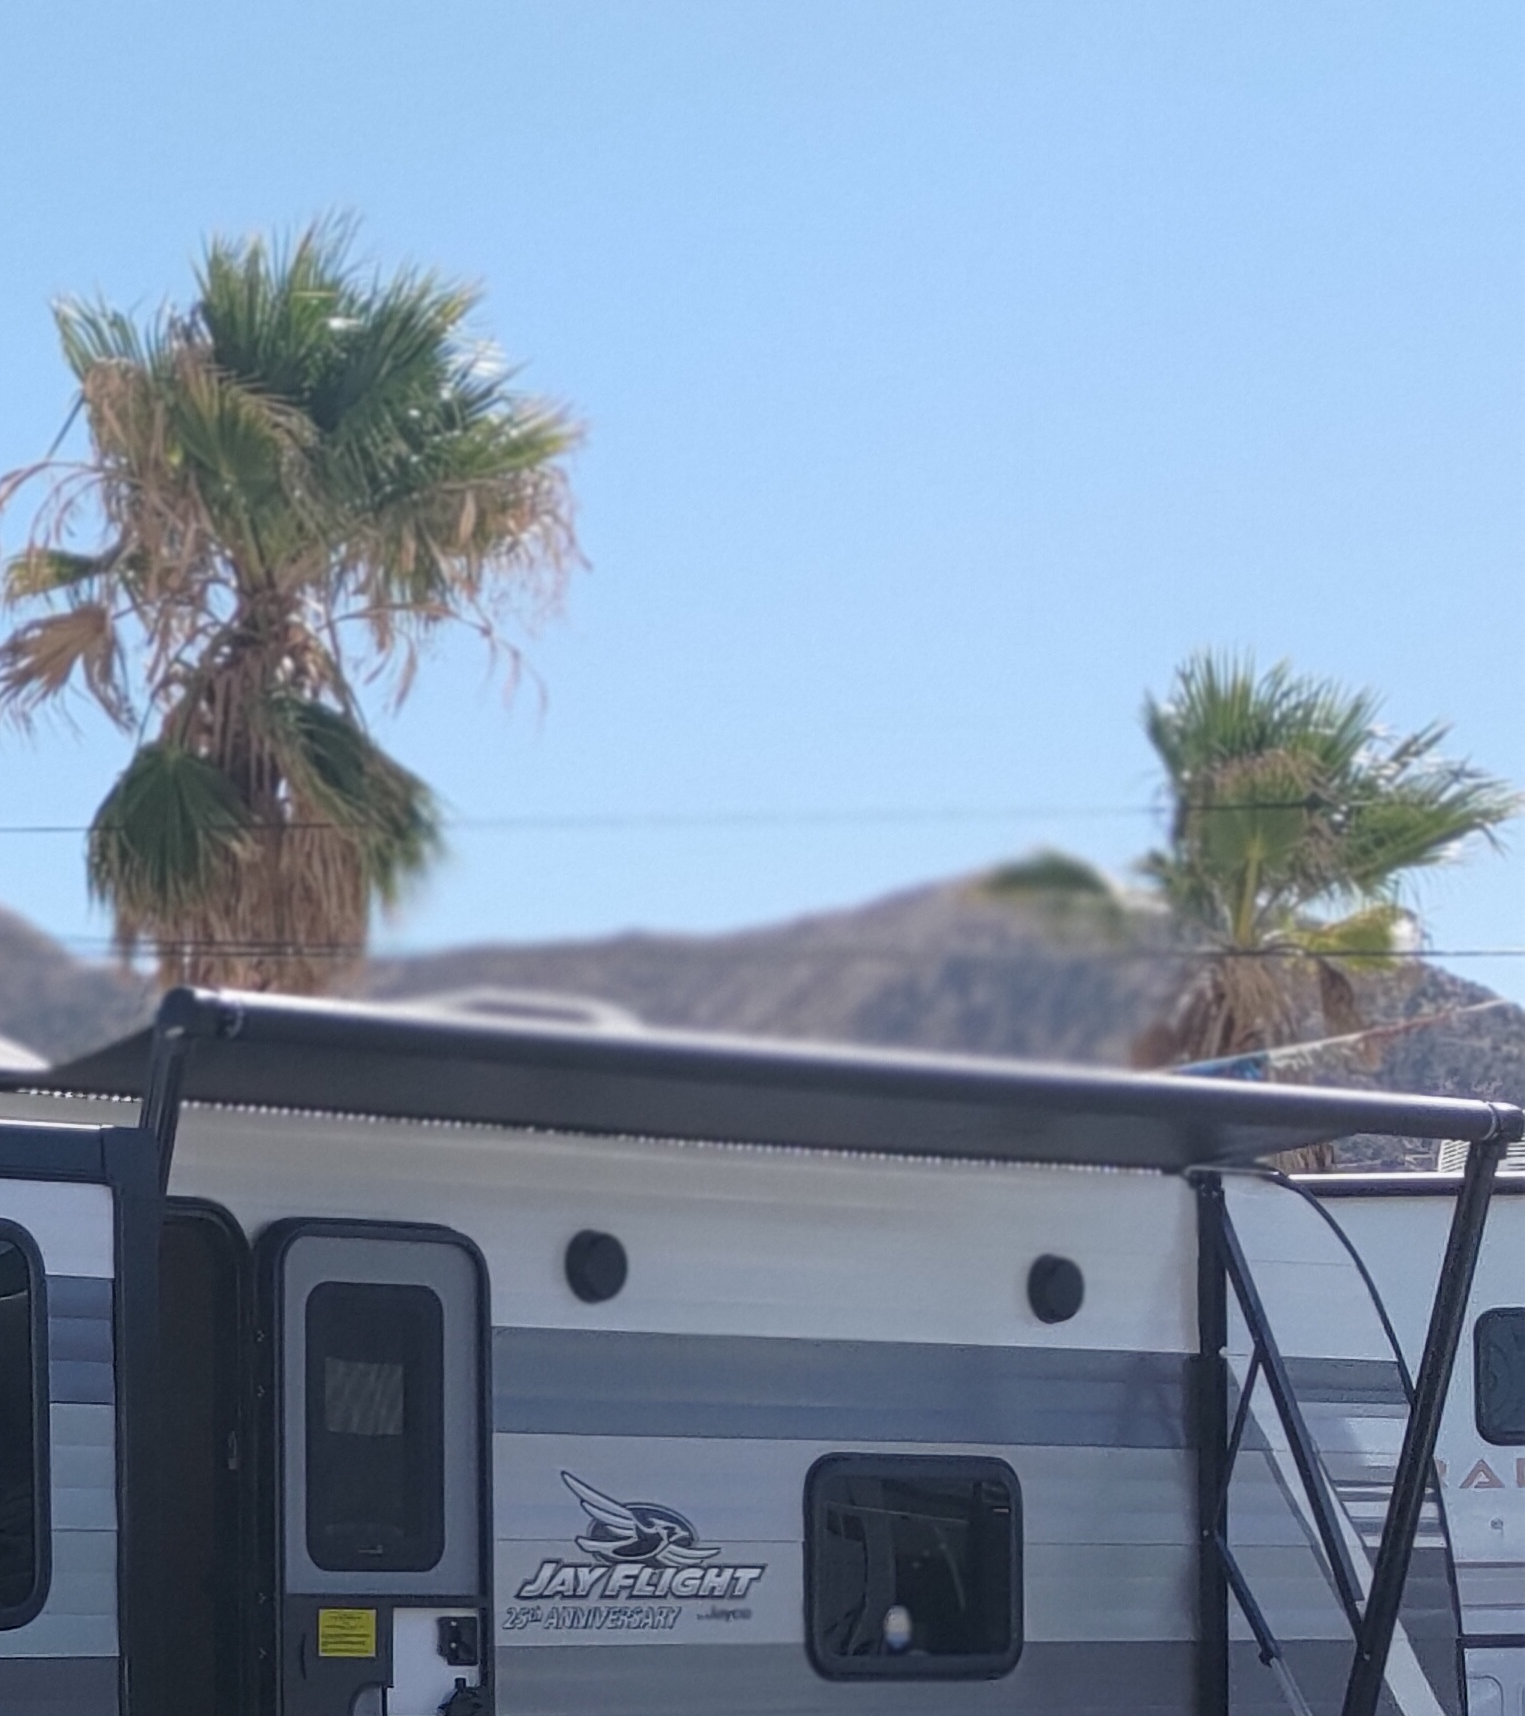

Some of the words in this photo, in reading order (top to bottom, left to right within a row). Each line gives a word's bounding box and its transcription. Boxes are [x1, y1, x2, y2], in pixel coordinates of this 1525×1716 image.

[514, 1558, 610, 1600] JAY
[600, 1562, 768, 1600] FLIGHT
[502, 1605, 543, 1630] 25th
[544, 1605, 683, 1630] ANNIVERSARY
